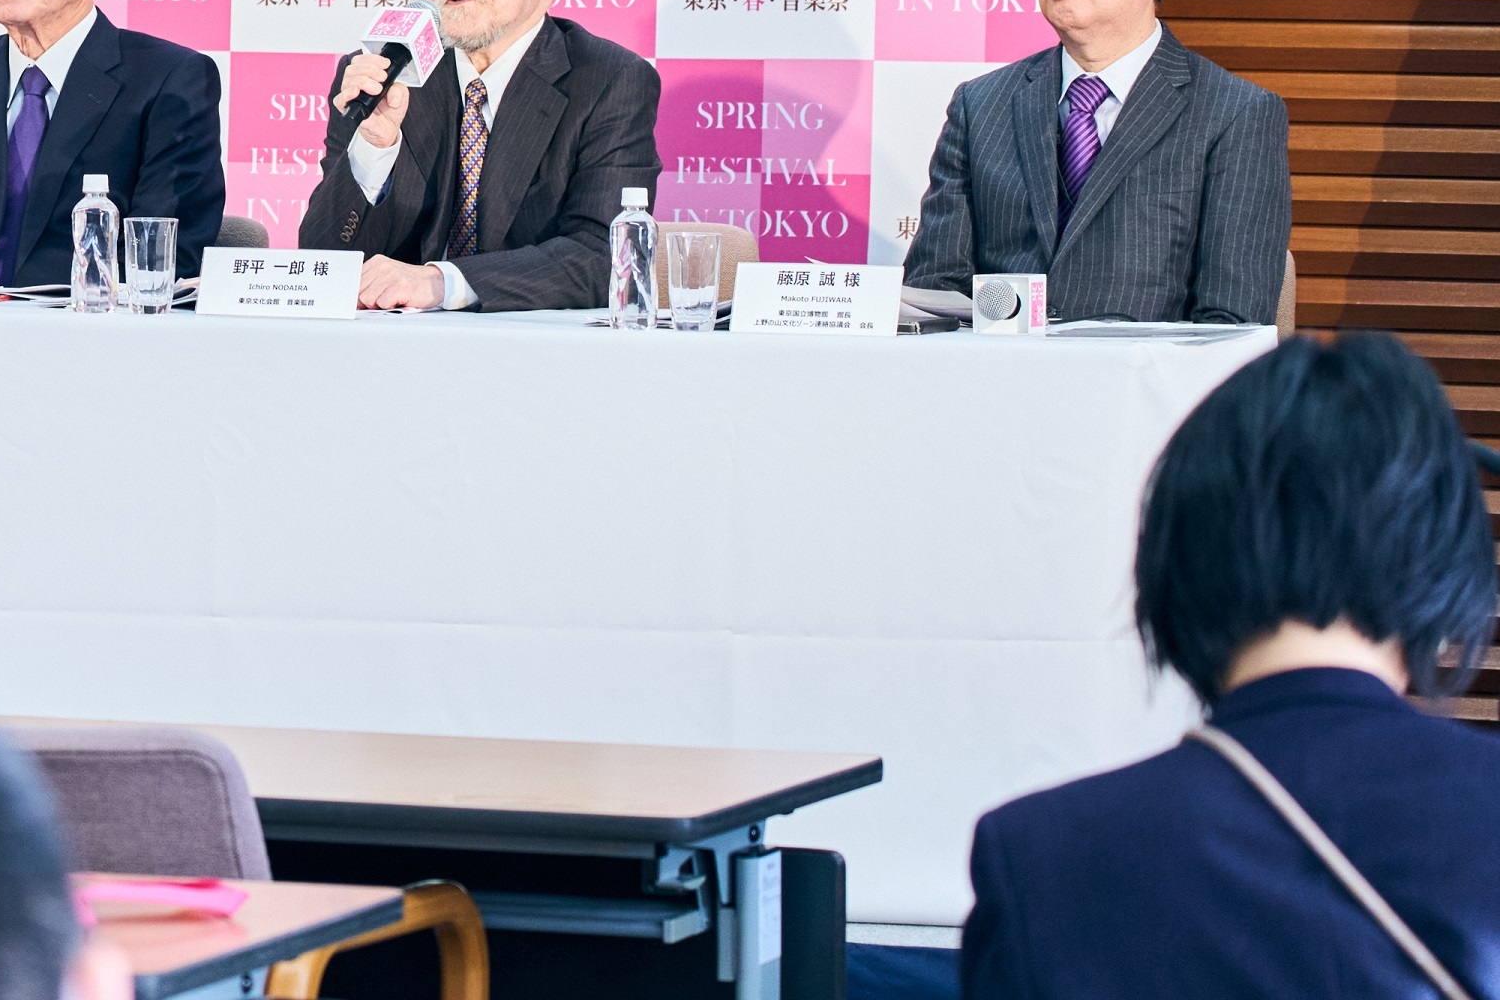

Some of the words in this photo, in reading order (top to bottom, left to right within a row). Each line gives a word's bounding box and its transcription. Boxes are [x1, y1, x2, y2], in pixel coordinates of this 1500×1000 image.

[696, 100, 824, 130] SPRING
[676, 156, 847, 187] FESTIVAL
[246, 198, 282, 226] IN
[233, 259, 265, 274] 野平
[273, 260, 305, 276] 一郎
[313, 261, 329, 276] 様
[248, 283, 271, 291] Ichiro
[272, 284, 308, 292] NODAIRA
[776, 270, 811, 287] 藤原
[818, 271, 836, 287] 誠
[843, 271, 860, 288] 様
[780, 295, 809, 303] Makoto
[811, 296, 852, 304] FUJIWARA
